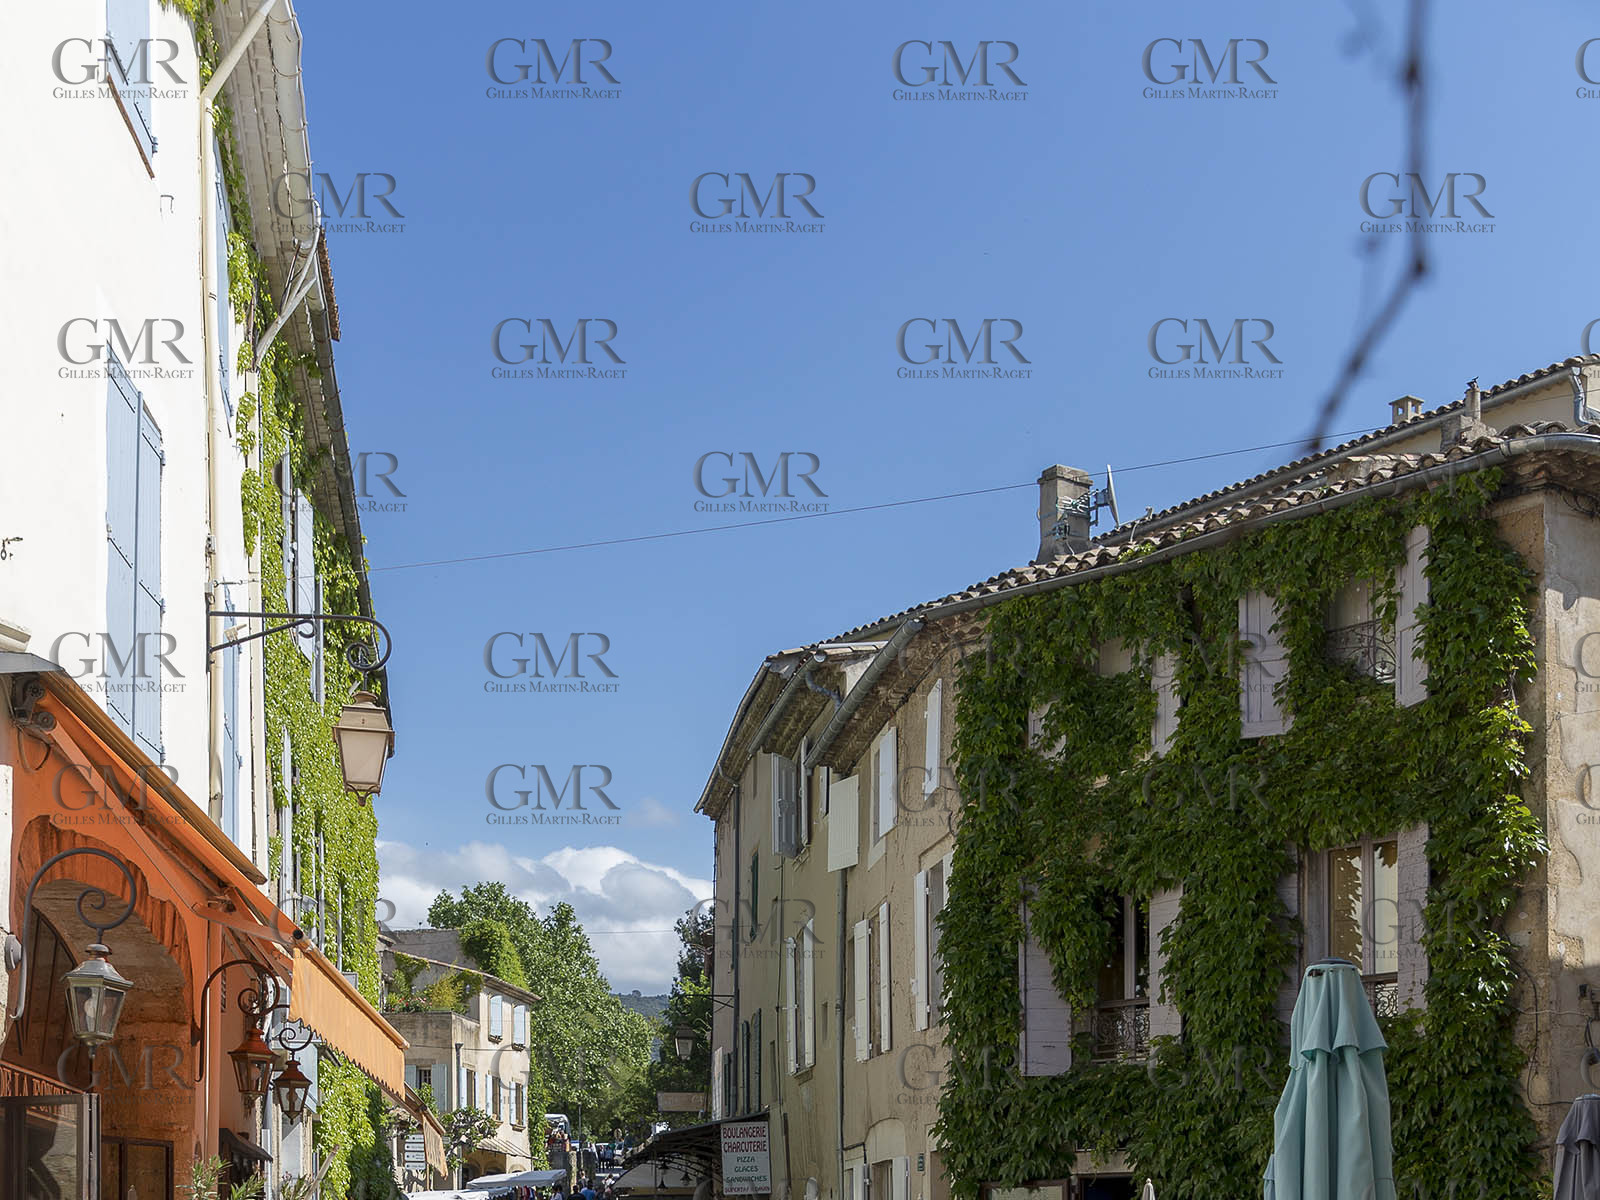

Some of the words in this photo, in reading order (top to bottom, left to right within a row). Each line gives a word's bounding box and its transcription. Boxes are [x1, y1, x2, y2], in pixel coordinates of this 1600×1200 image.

[723, 1127, 767, 1138] BOULANGERIE
[723, 1141, 767, 1153] CHARCUTERIE
[726, 1176, 768, 1184] SANDWICHES
